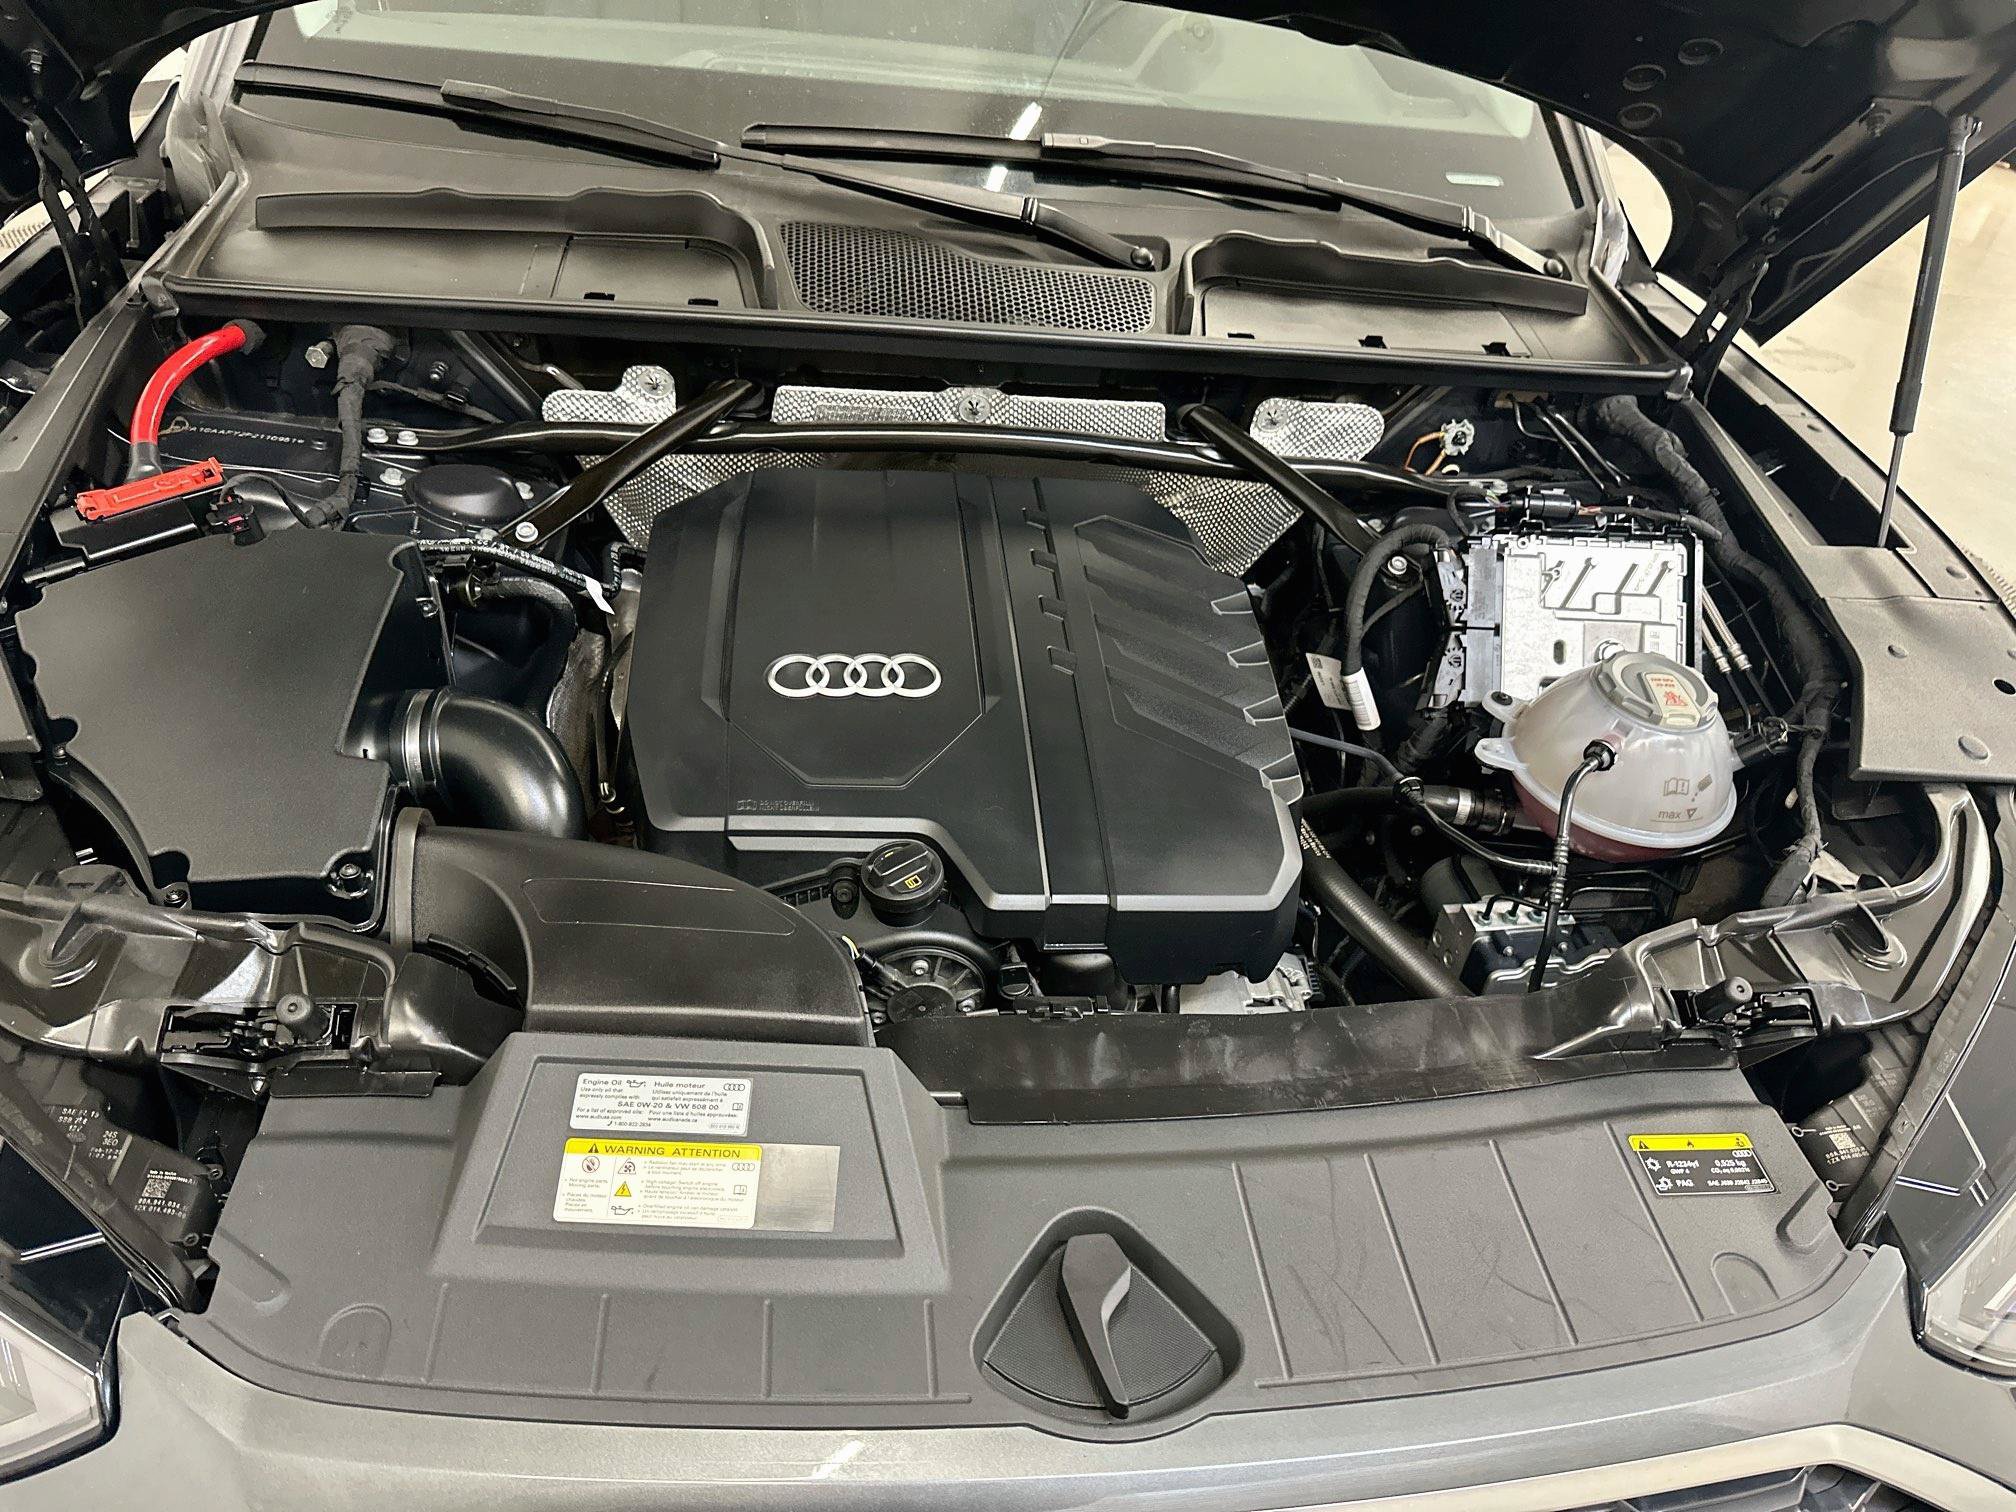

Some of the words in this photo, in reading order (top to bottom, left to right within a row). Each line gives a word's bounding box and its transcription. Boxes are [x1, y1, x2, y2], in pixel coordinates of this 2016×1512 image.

[1657, 810, 1681, 820] max
[604, 1144, 665, 1156] WARNING
[672, 1147, 741, 1158] ATTENTION
[1675, 1179, 1694, 1187] PAG
